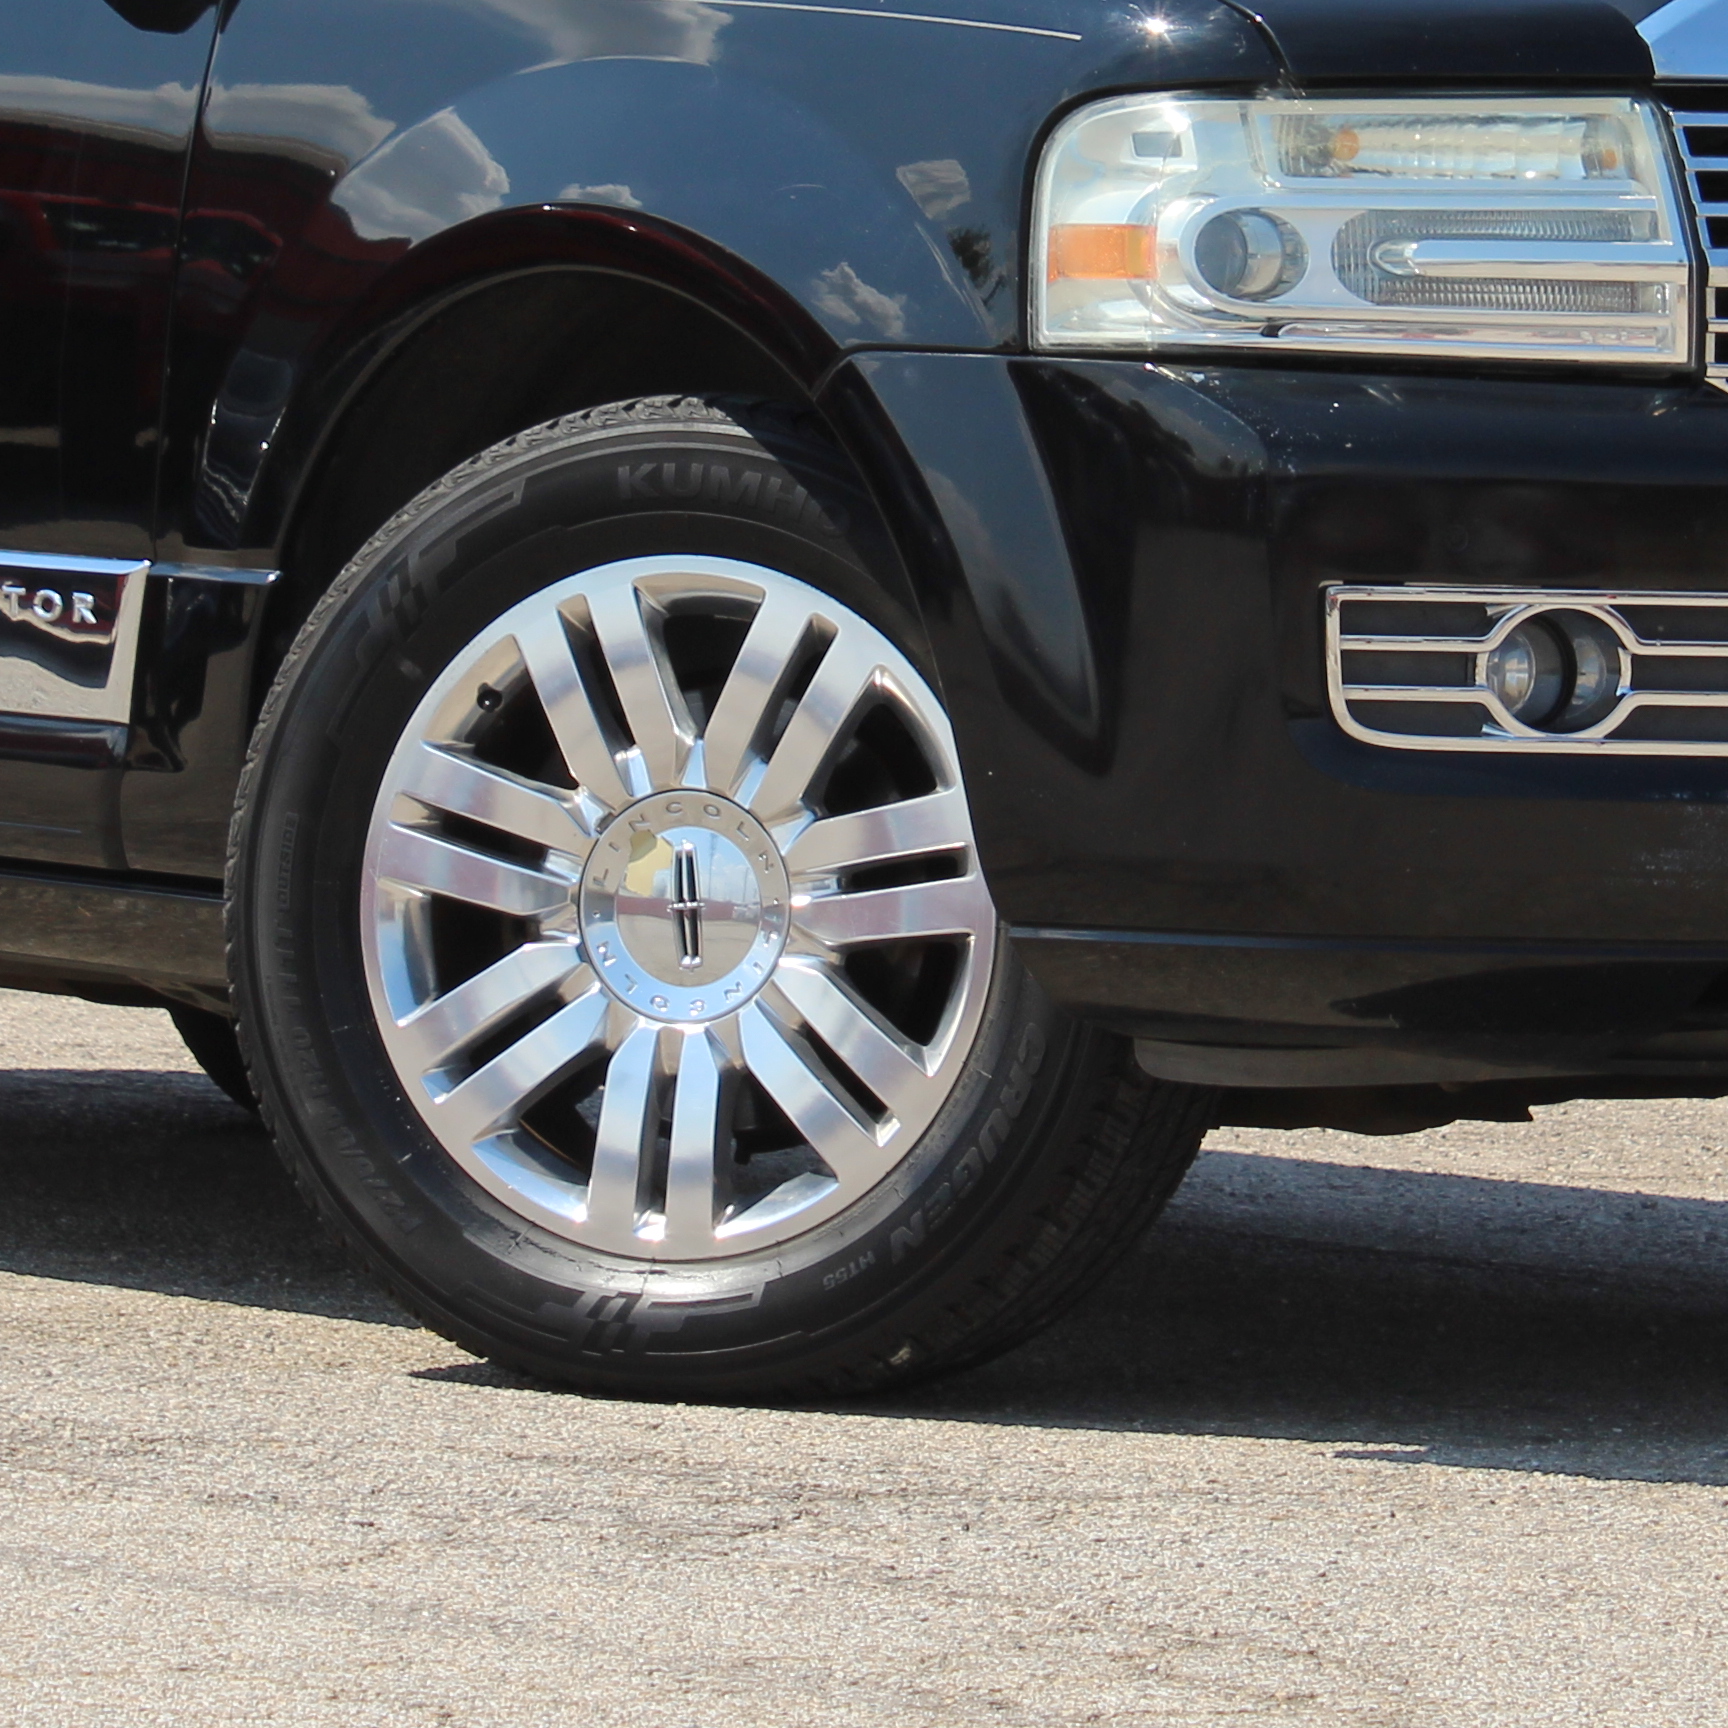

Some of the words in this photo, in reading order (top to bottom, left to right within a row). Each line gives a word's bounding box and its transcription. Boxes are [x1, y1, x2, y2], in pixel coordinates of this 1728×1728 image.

[617, 462, 850, 536] KUMHO
[276, 813, 298, 906] OUTSIDE
[593, 801, 774, 887] LINCOLN
[596, 930, 779, 1016] LINCOLN
[889, 1021, 1047, 1265] CRUGEN
[821, 1250, 877, 1290] HT55
